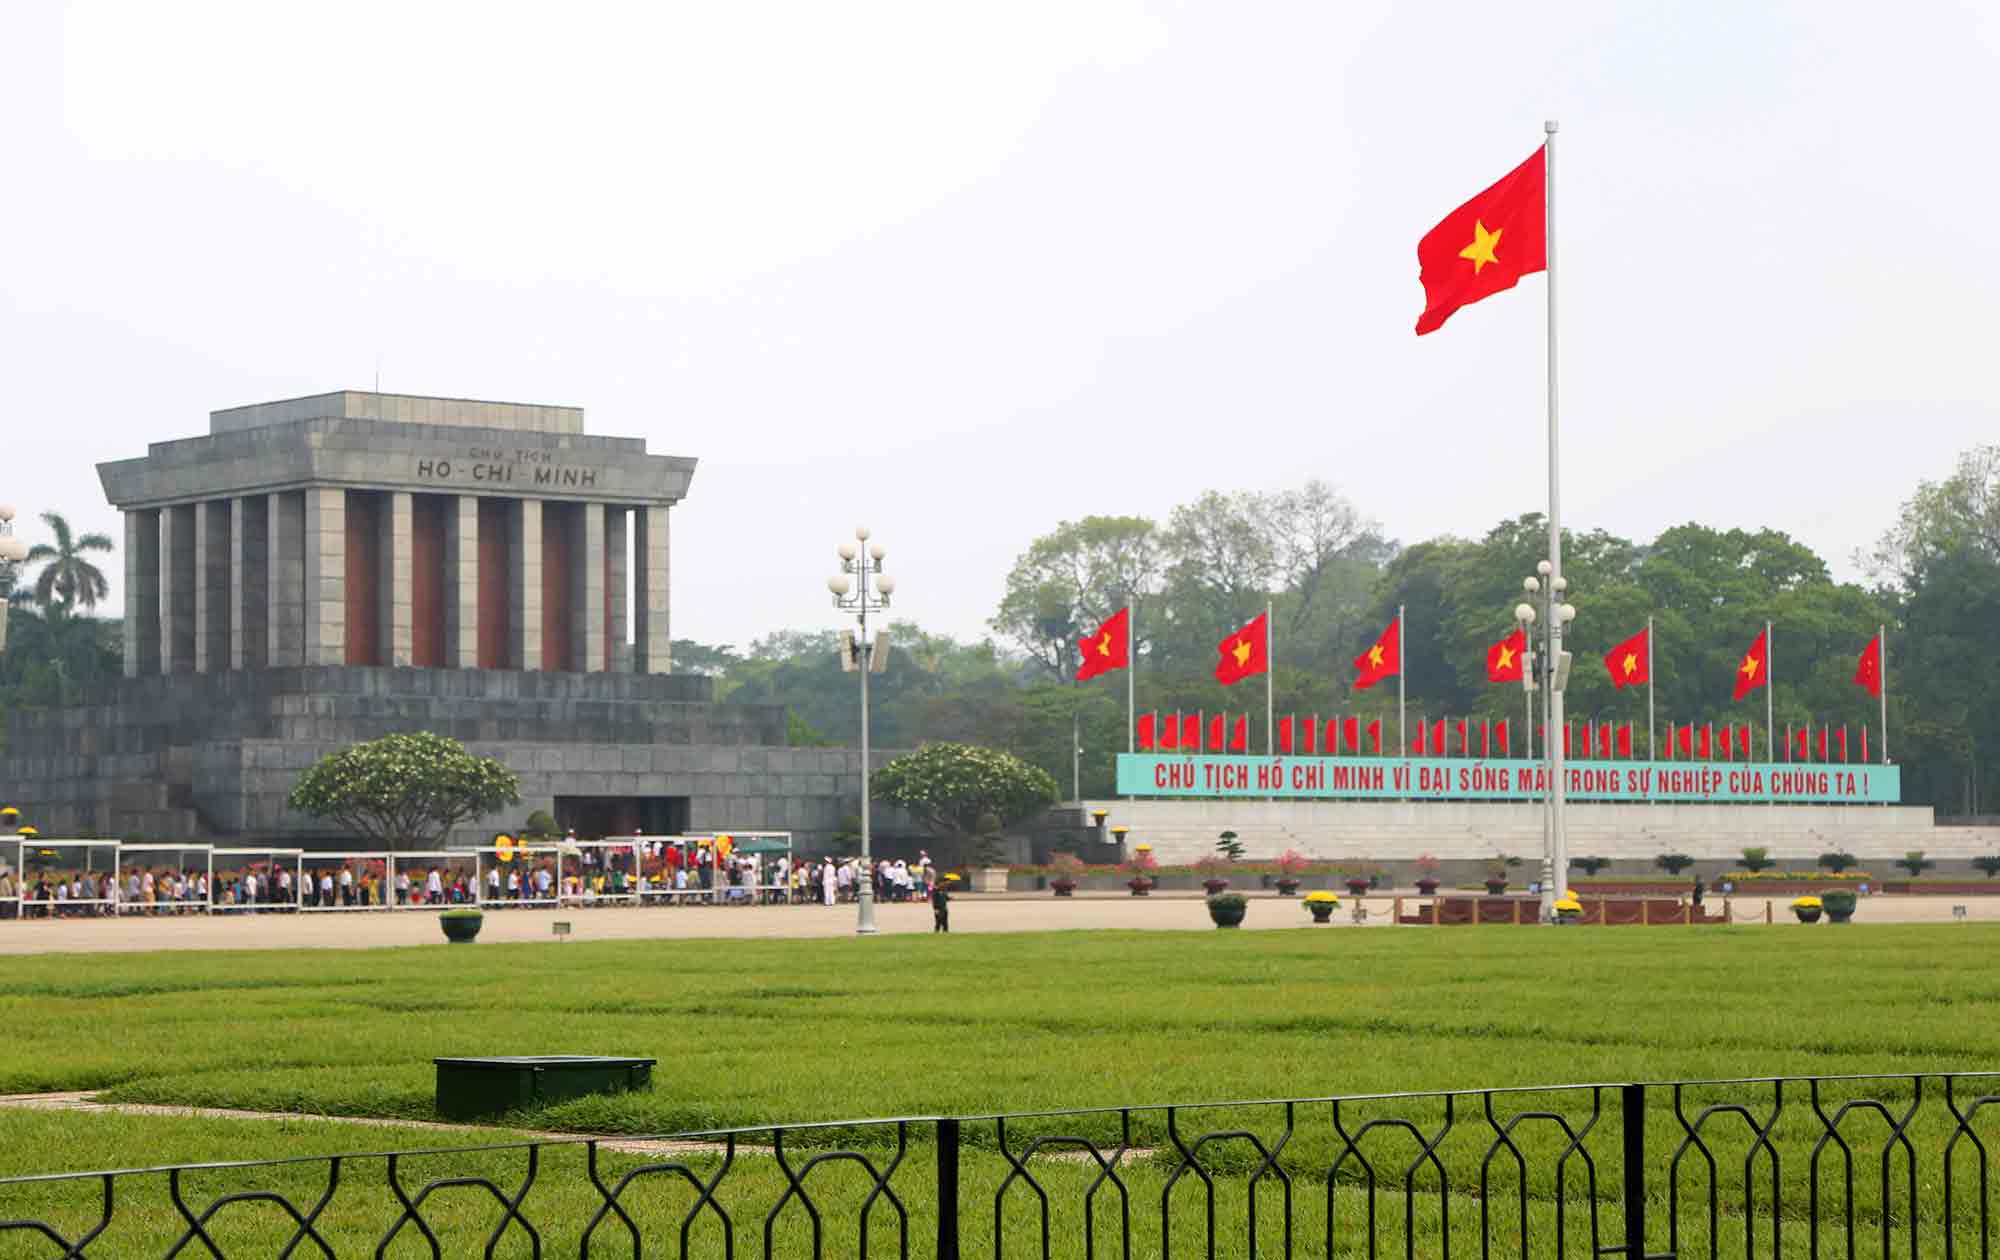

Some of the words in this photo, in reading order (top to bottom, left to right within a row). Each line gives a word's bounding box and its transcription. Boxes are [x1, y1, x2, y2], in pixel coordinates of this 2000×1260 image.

[1155, 756, 1195, 788] CHỦ
[1204, 763, 1249, 793] TỊCH
[1293, 760, 1324, 790] CHÍ
[1333, 764, 1384, 791] MINH
[1419, 766, 1450, 796] ĐẠI
[1459, 761, 1509, 792] SỐNG
[1627, 767, 1651, 798] SỰ
[1658, 765, 1722, 798] NGHIỆP
[1729, 764, 1763, 793] CỦA
[1771, 767, 1828, 794] CHÚNG
[1836, 772, 1856, 795] TA
